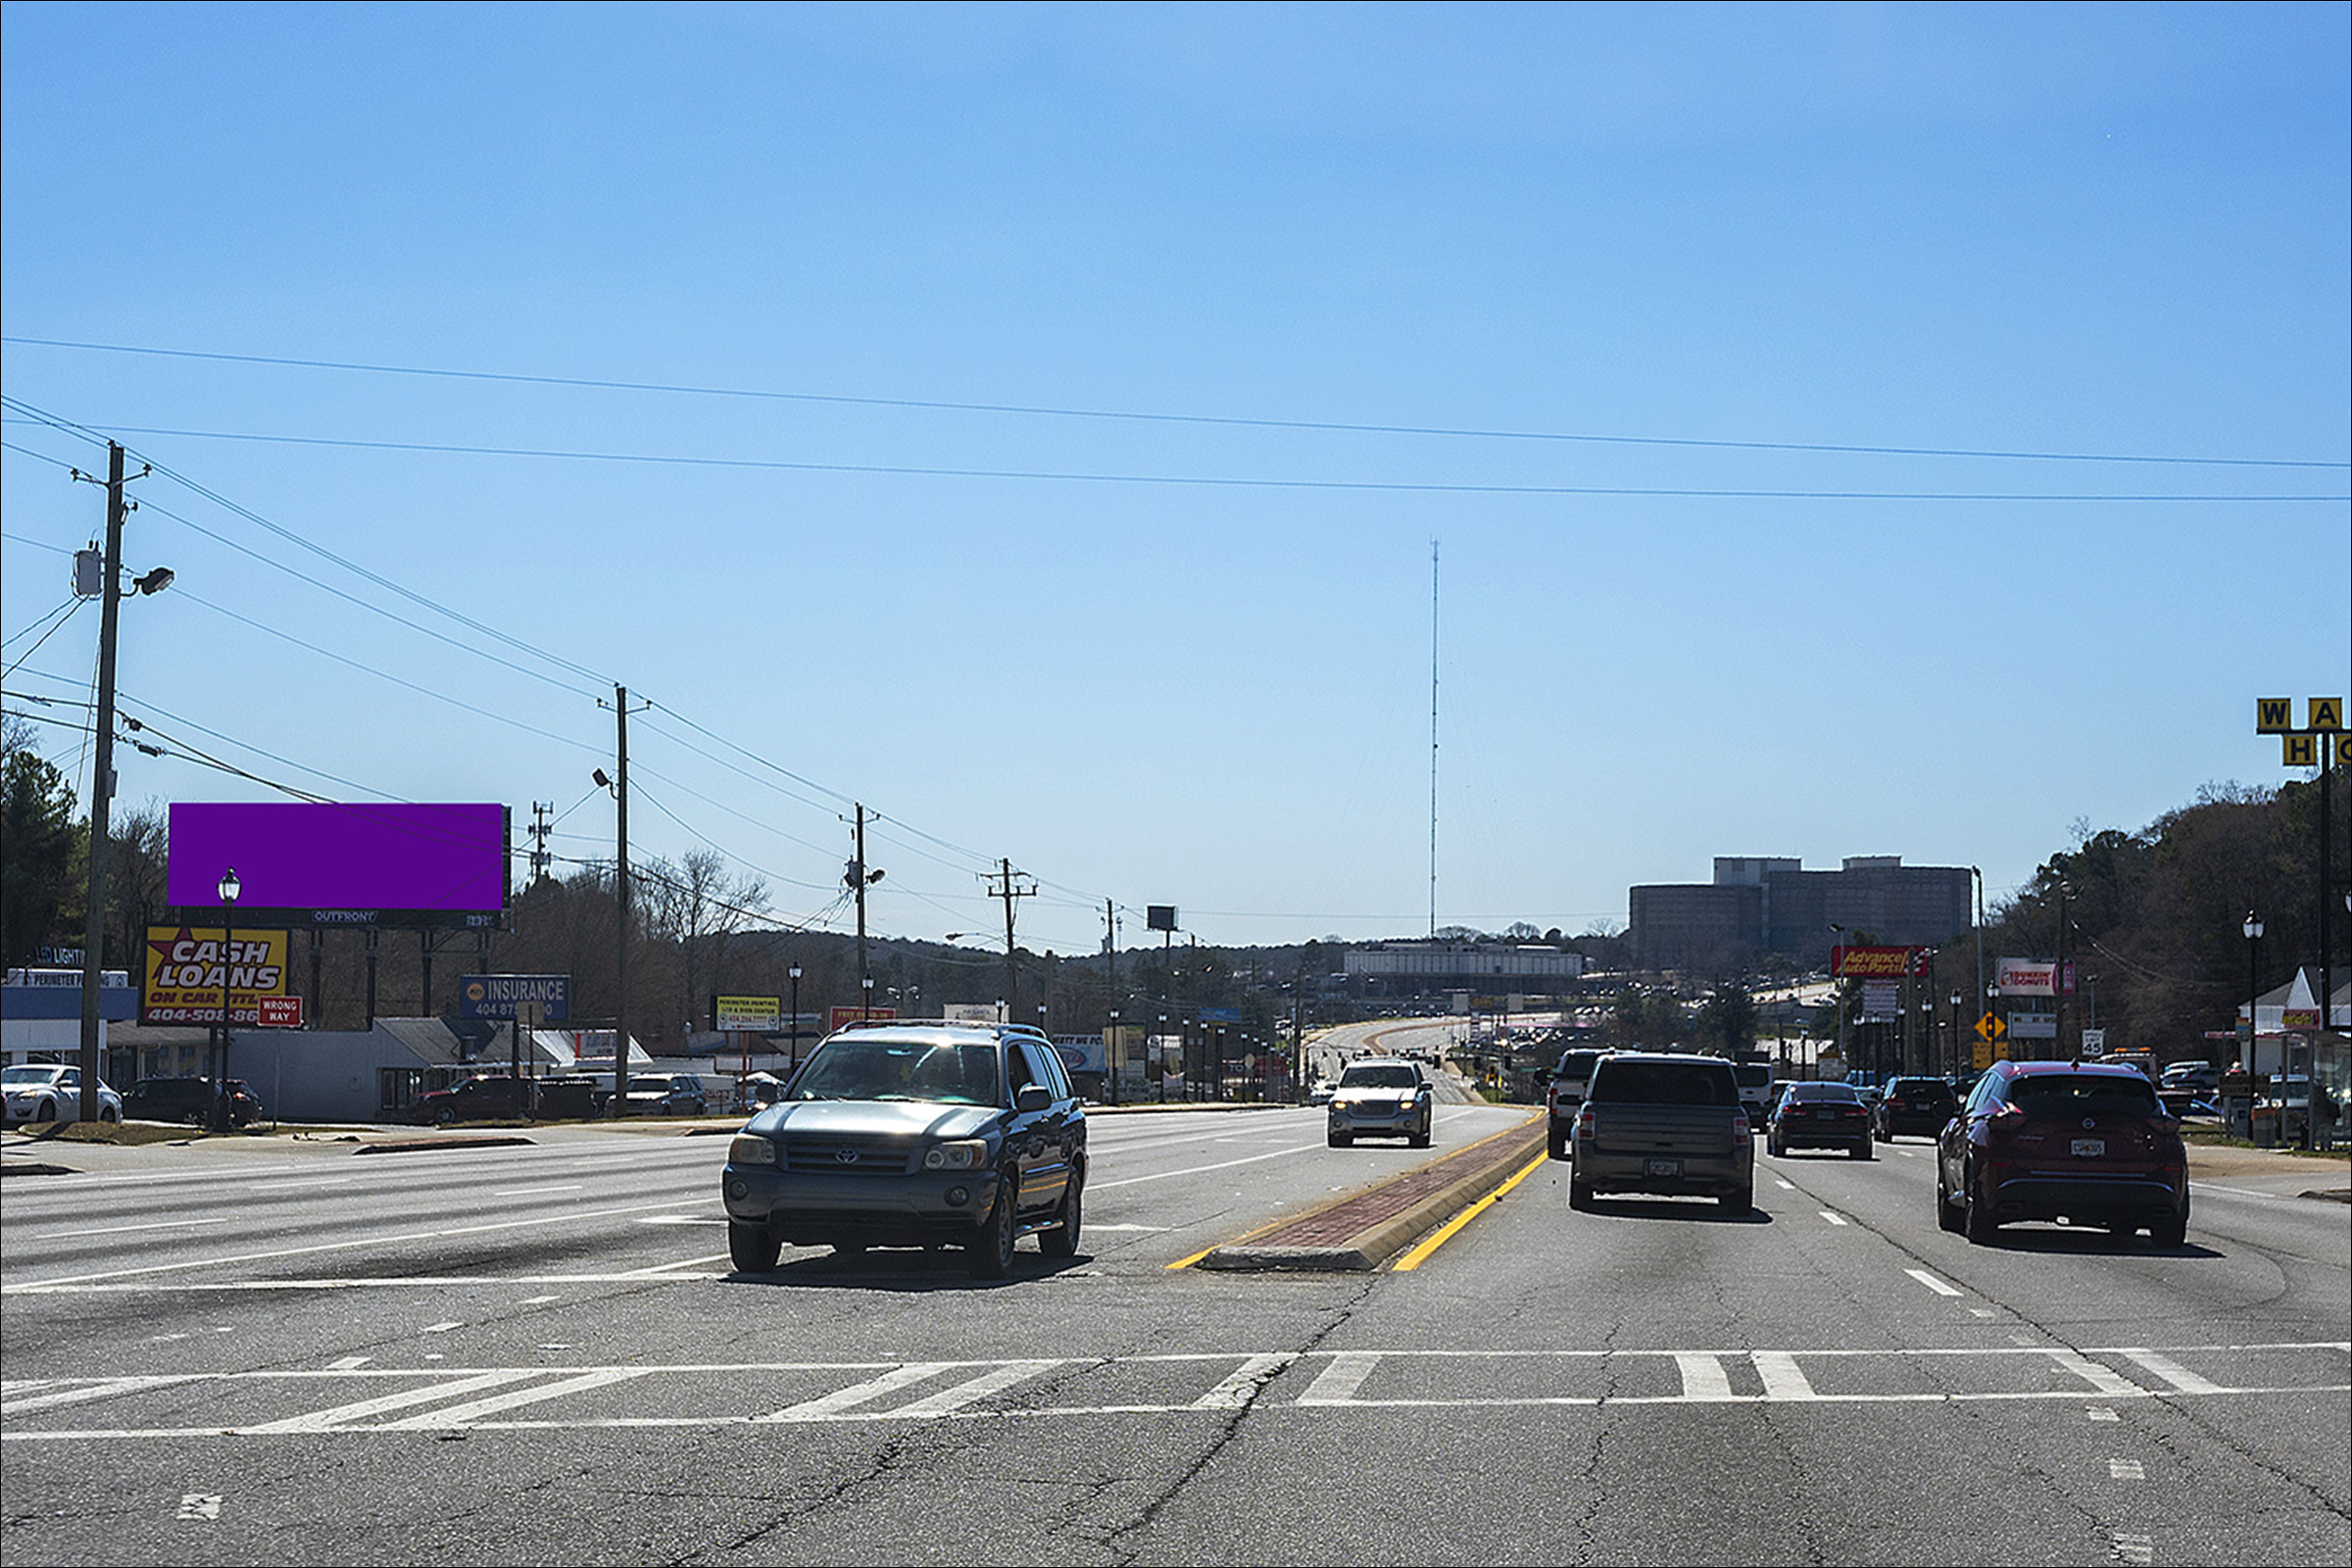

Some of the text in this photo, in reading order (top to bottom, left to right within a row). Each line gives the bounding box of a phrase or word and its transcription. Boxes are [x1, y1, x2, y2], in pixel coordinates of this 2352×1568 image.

[314, 910, 374, 922] OUTFRONT
[172, 940, 269, 964] CASH
[1844, 952, 1902, 963] Advance
[1867, 961, 1904, 973] Parts
[158, 965, 279, 989] LOANS
[488, 980, 564, 1000] INSURANCE
[149, 992, 177, 1004] ON
[181, 992, 219, 1004] CAR
[263, 1001, 297, 1010] WRONG
[475, 1004, 497, 1015] 404
[269, 1012, 290, 1021] WAY
[2083, 1043, 2101, 1054] 45
